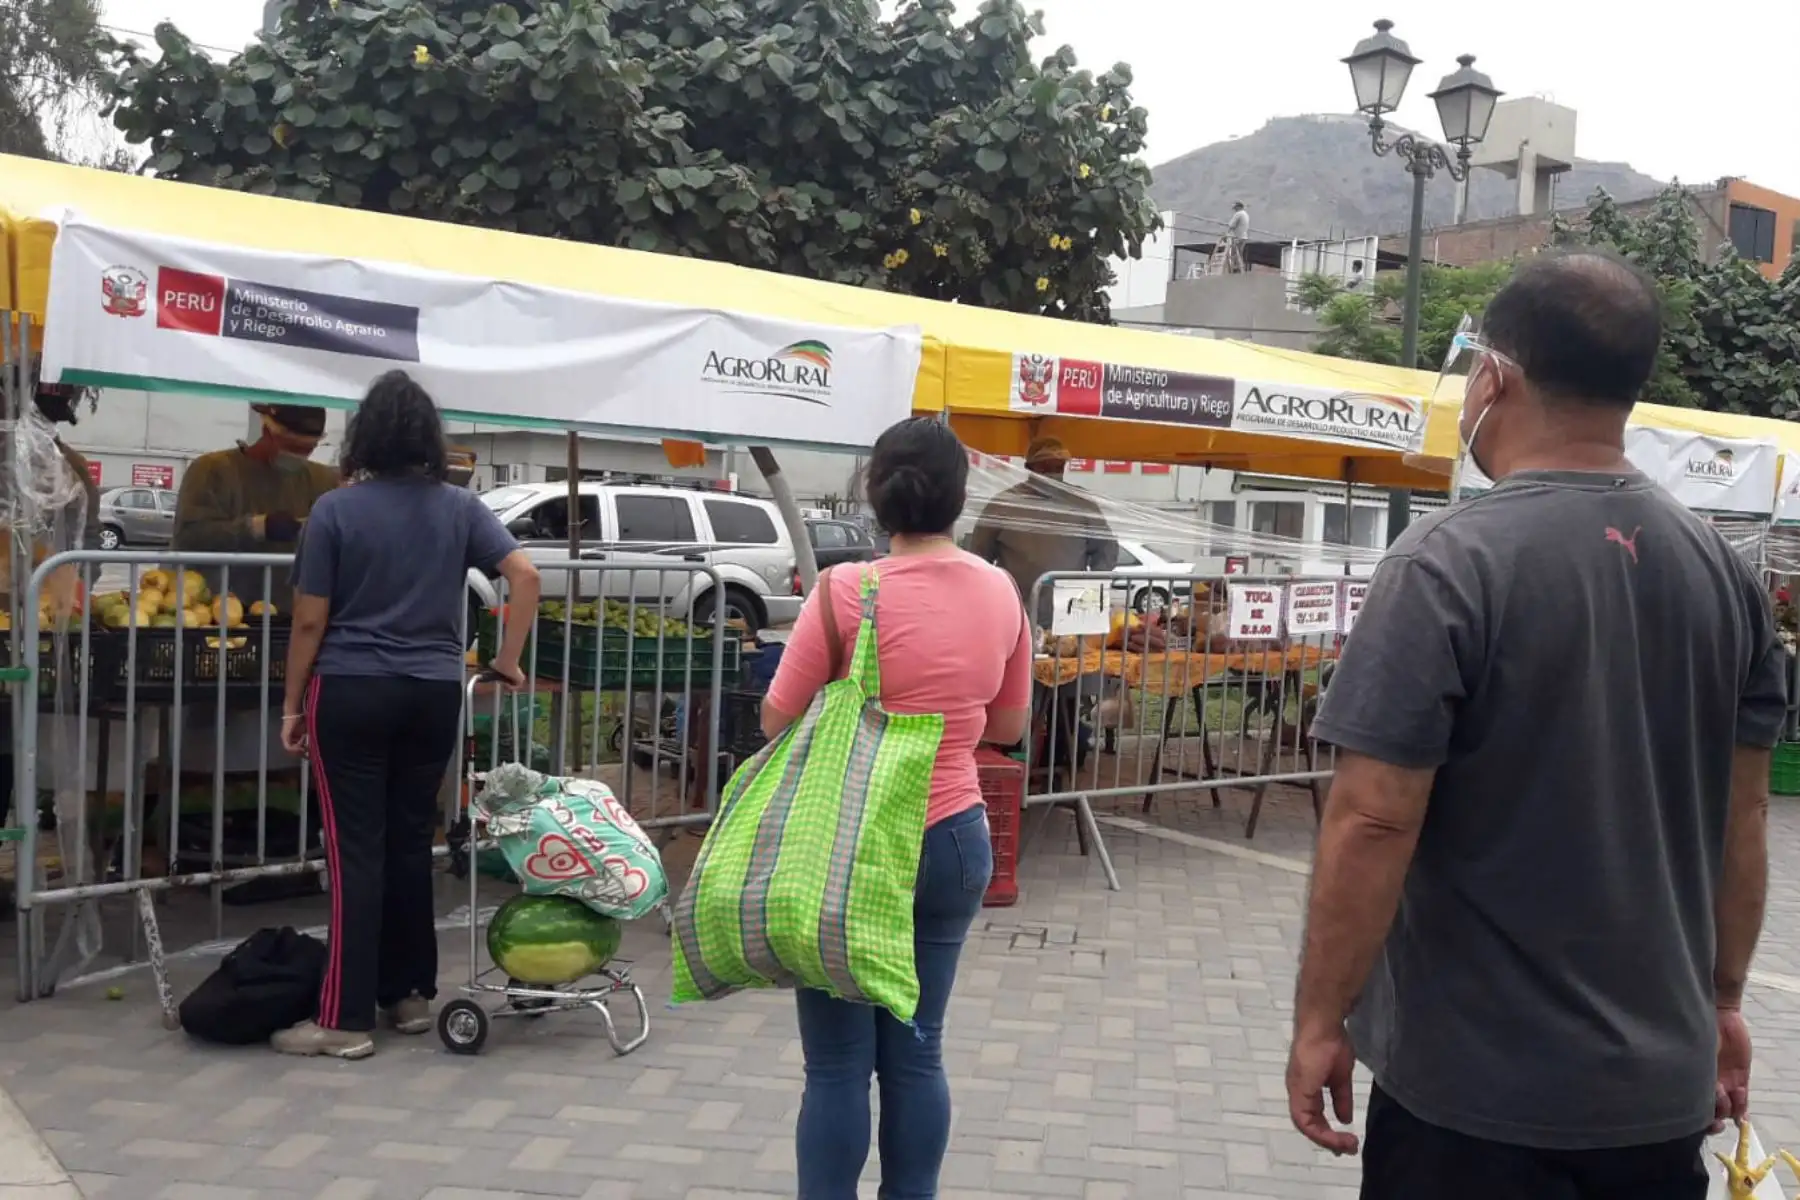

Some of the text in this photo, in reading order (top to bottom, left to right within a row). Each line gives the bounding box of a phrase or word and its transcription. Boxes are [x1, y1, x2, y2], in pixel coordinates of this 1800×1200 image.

[163, 289, 215, 313] PERÚ
[234, 287, 308, 312] Ministerio
[230, 318, 286, 338] y Riego
[231, 303, 386, 338] de Desarrollo Agrario
[1062, 365, 1097, 390] PERÚ
[1108, 364, 1168, 388] Ministerio
[1107, 388, 1230, 417] de Agricultura y Riego
[1236, 412, 1276, 426] PROGRAMA
[1276, 417, 1287, 427] DE
[1287, 419, 1329, 432] DESARROLLO
[1329, 424, 1369, 437] PRODUCTIVO
[1244, 590, 1273, 603] YUCA
[1293, 598, 1333, 609] AMARILLO
